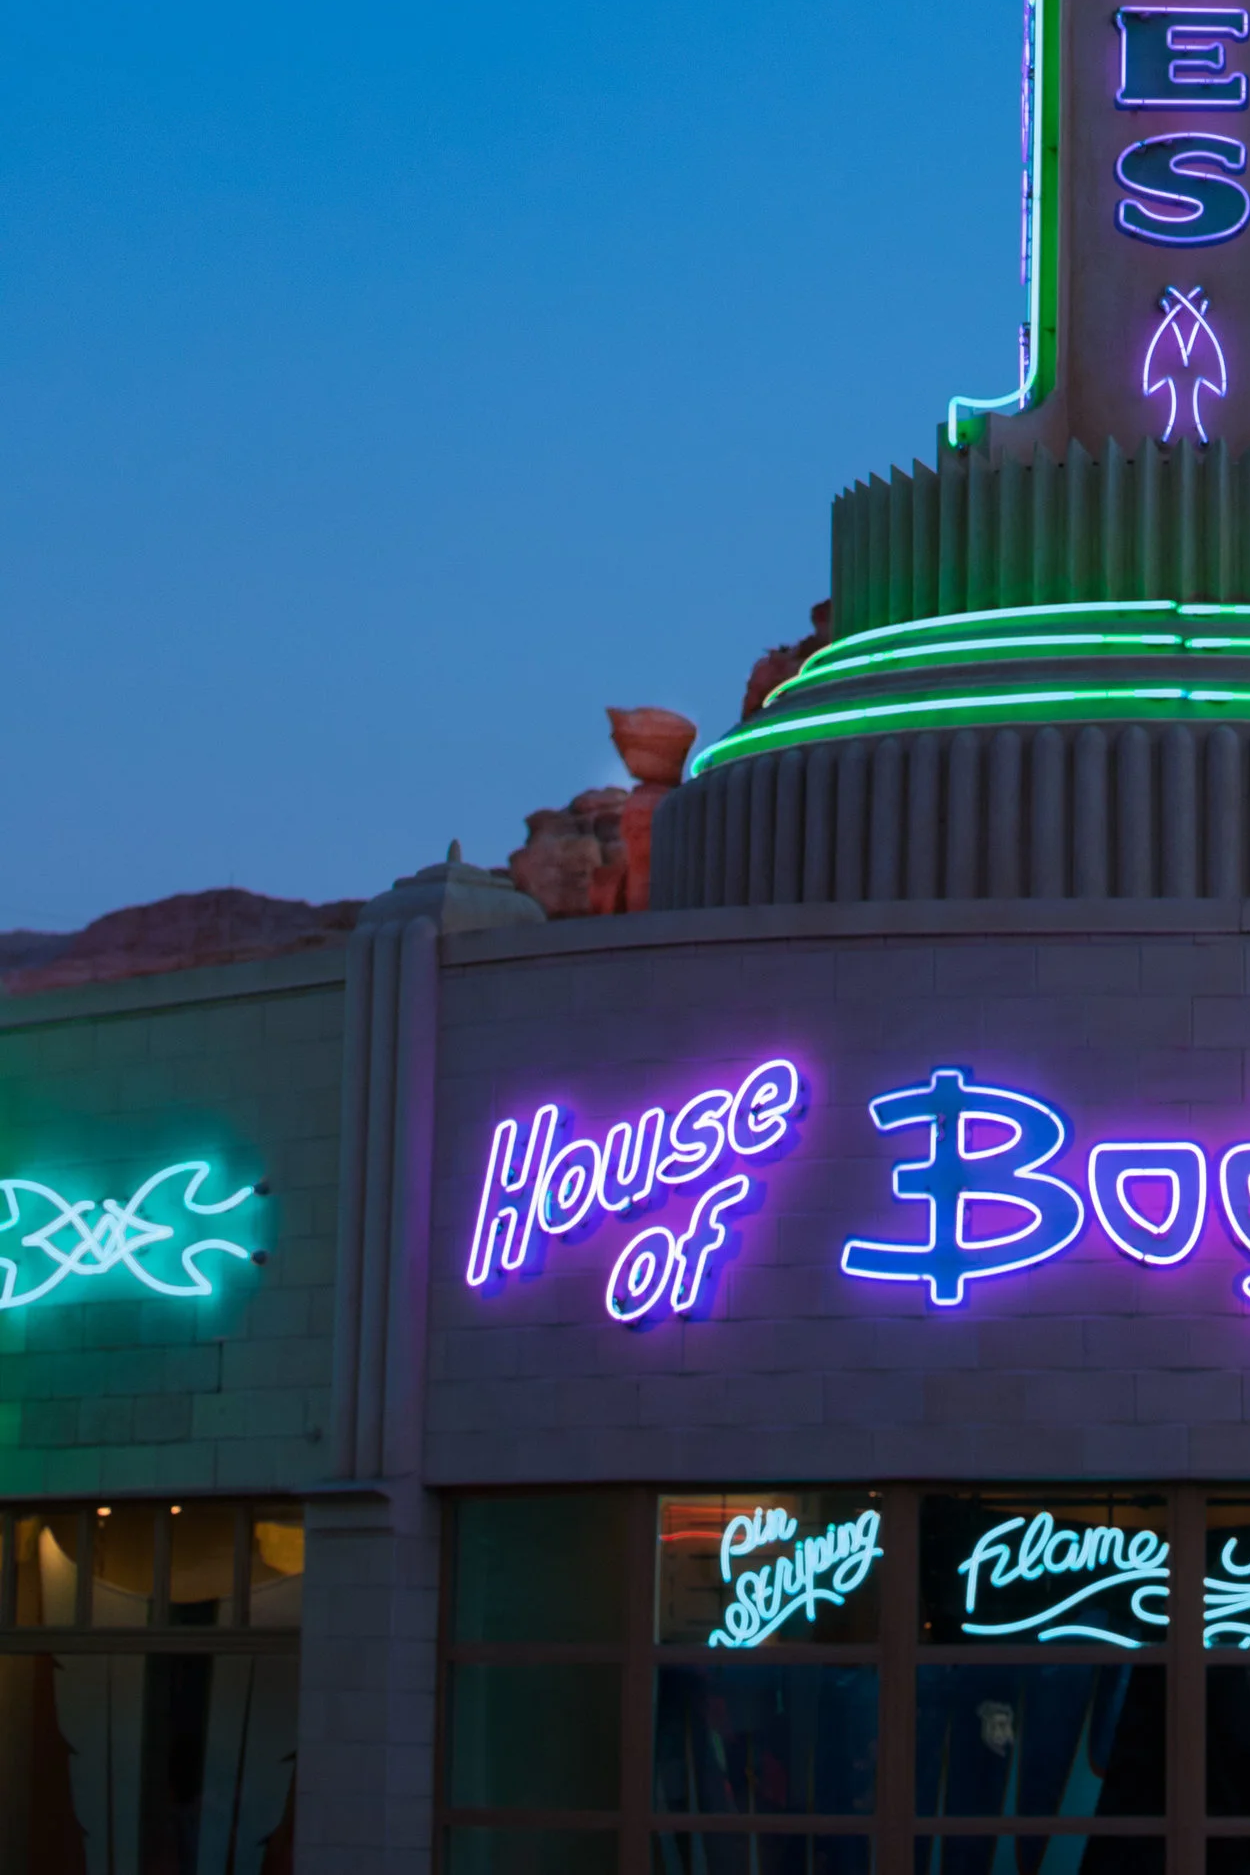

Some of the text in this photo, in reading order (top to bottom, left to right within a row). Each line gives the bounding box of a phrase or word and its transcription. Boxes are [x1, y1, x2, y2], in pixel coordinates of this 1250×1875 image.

[466, 1058, 800, 1286] House
[606, 1173, 750, 1322] of
[957, 1511, 1170, 1613] Flame
